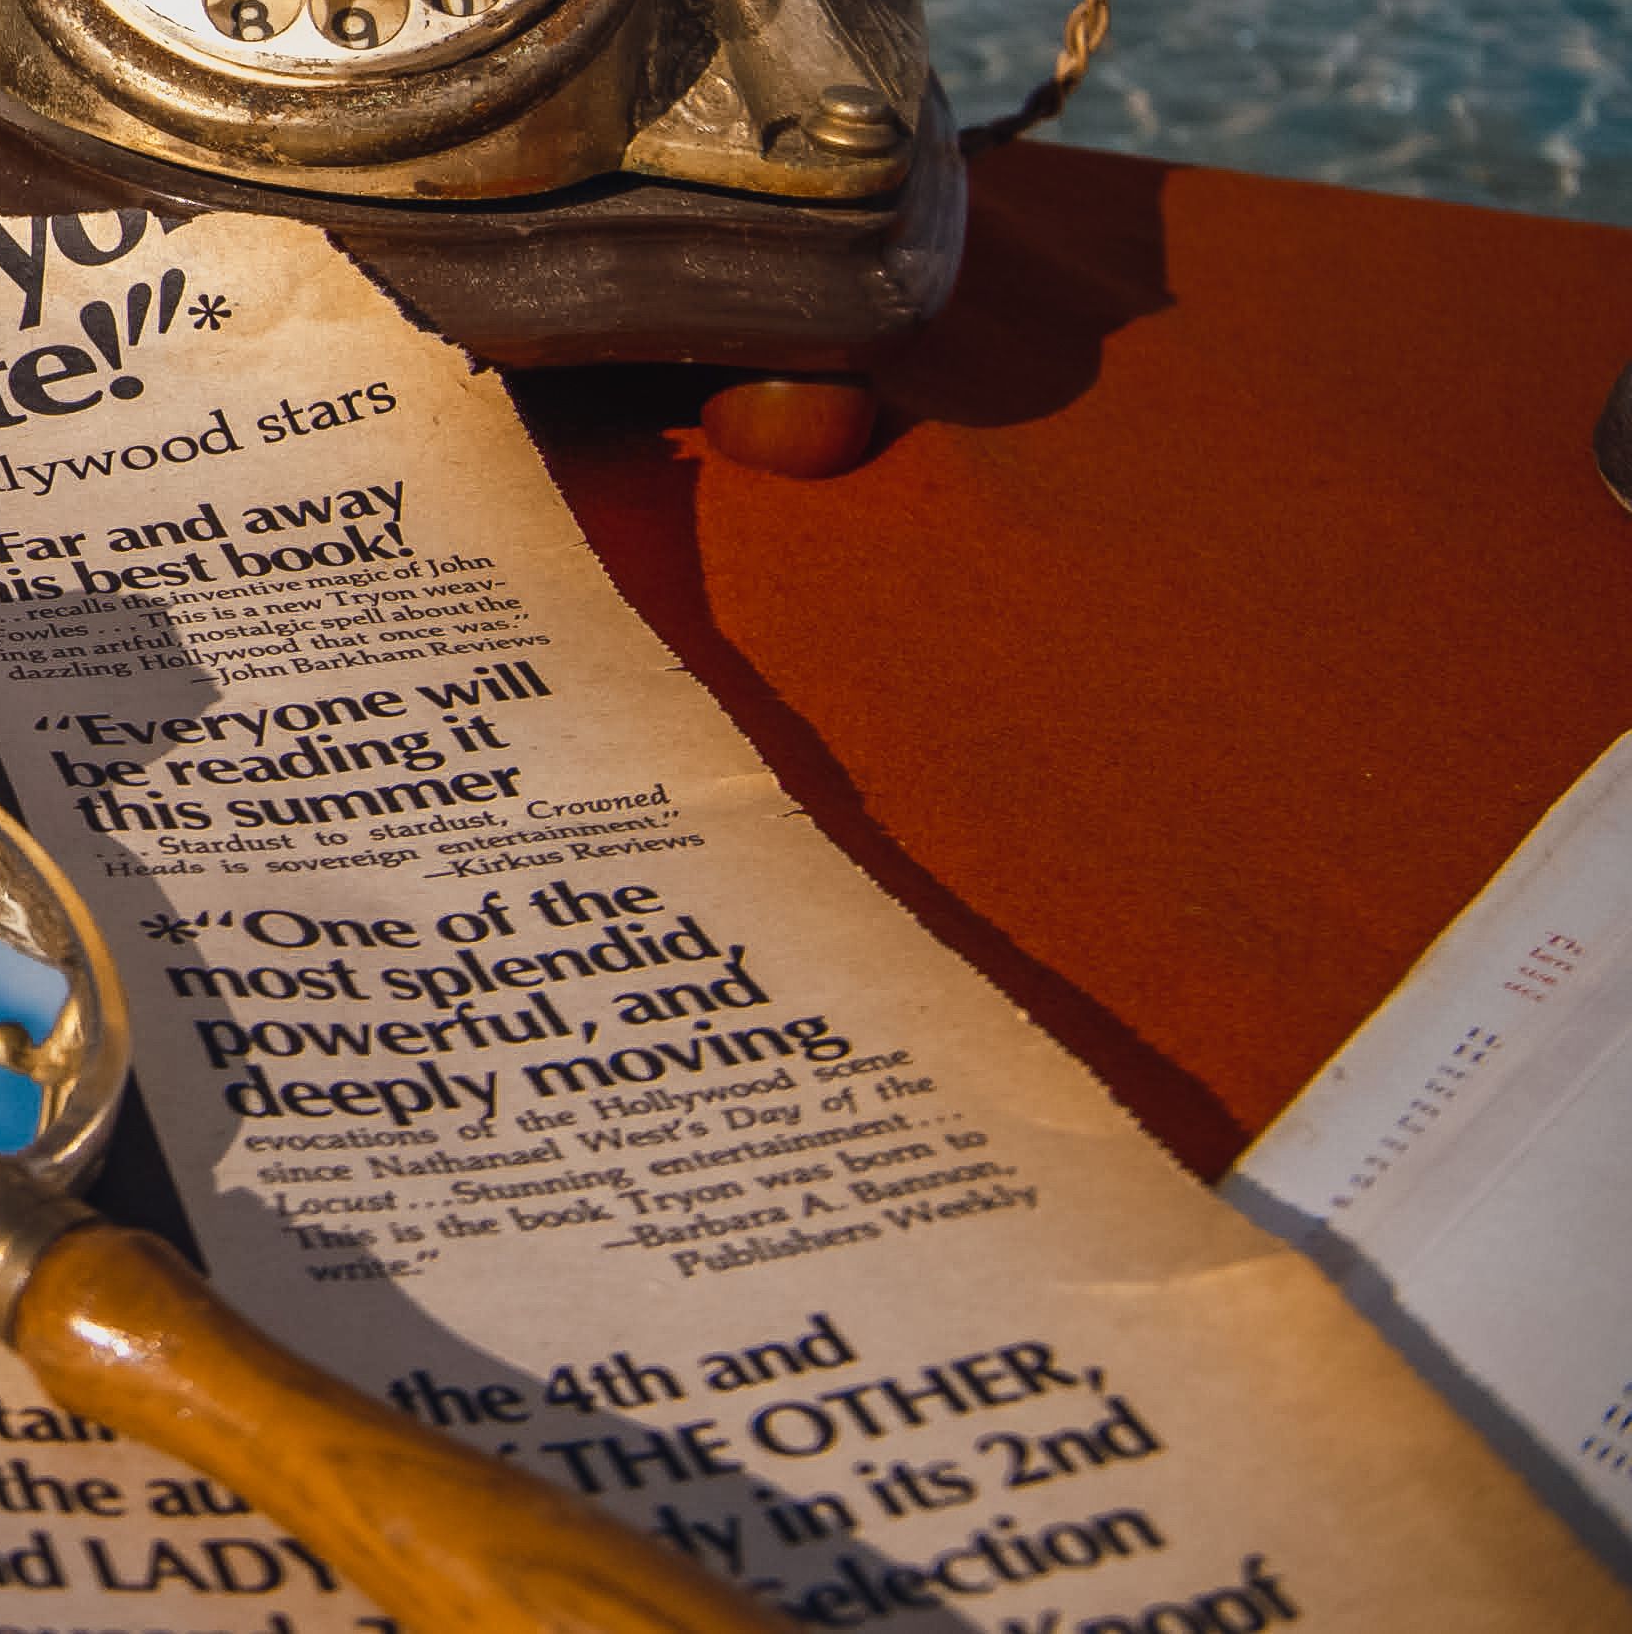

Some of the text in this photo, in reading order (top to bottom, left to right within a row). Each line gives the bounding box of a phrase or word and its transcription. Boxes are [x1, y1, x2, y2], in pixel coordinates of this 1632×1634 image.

[232, 0, 273, 39] 8
[335, 6, 379, 49] 9
[260, 381, 398, 445] stars
[108, 503, 227, 554] and
[246, 480, 404, 536] away
[79, 550, 216, 596] best
[221, 521, 415, 579] book!
[121, 594, 167, 609] the
[168, 580, 306, 604] inventive
[306, 569, 390, 587] magic
[393, 561, 420, 580] of
[424, 555, 496, 578] John
[53, 646, 87, 659] an
[93, 632, 183, 656] artful,
[188, 618, 317, 644] nostalgic
[320, 607, 385, 631] spell
[393, 605, 473, 622] about
[475, 596, 522, 613] the
[139, 611, 206, 629] This
[214, 607, 236, 620] is
[243, 606, 259, 617] a
[264, 598, 322, 615] new
[326, 589, 418, 607] Tryon
[422, 579, 506, 598] weav-
[9, 664, 132, 681] dazzling
[138, 637, 301, 671] Hollywood
[311, 632, 369, 650] that
[379, 627, 445, 643] once
[289, 648, 425, 674] Barkham
[427, 633, 552, 656] Reviews
[415, 661, 552, 714] will
[51, 714, 510, 789] be reading it
[73, 763, 522, 834] this summer
[158, 784, 671, 857] Stardust to stardust, Crowned
[105, 860, 205, 878] Heads
[223, 857, 249, 874] is
[266, 844, 421, 874] sovereign
[571, 832, 706, 861] Reviews
[437, 891, 517, 945] of
[536, 878, 663, 916] the
[168, 914, 746, 1008] most splendid,
[195, 957, 769, 1069] powerful, and
[223, 1014, 853, 1127] deeply moving
[244, 1049, 913, 1152] evocations of the Hollywood scene
[671, 1184, 1038, 1278] Publishers Weekly
[389, 1314, 857, 1429] the 4th and
[542, 1339, 1106, 1497] THE OTHER,
[752, 1488, 858, 1546] in
[854, 1462, 977, 1517] its
[974, 1395, 1166, 1489] 2nd
[85, 1537, 343, 1595] LADY
[749, 1507, 1166, 1627] election
